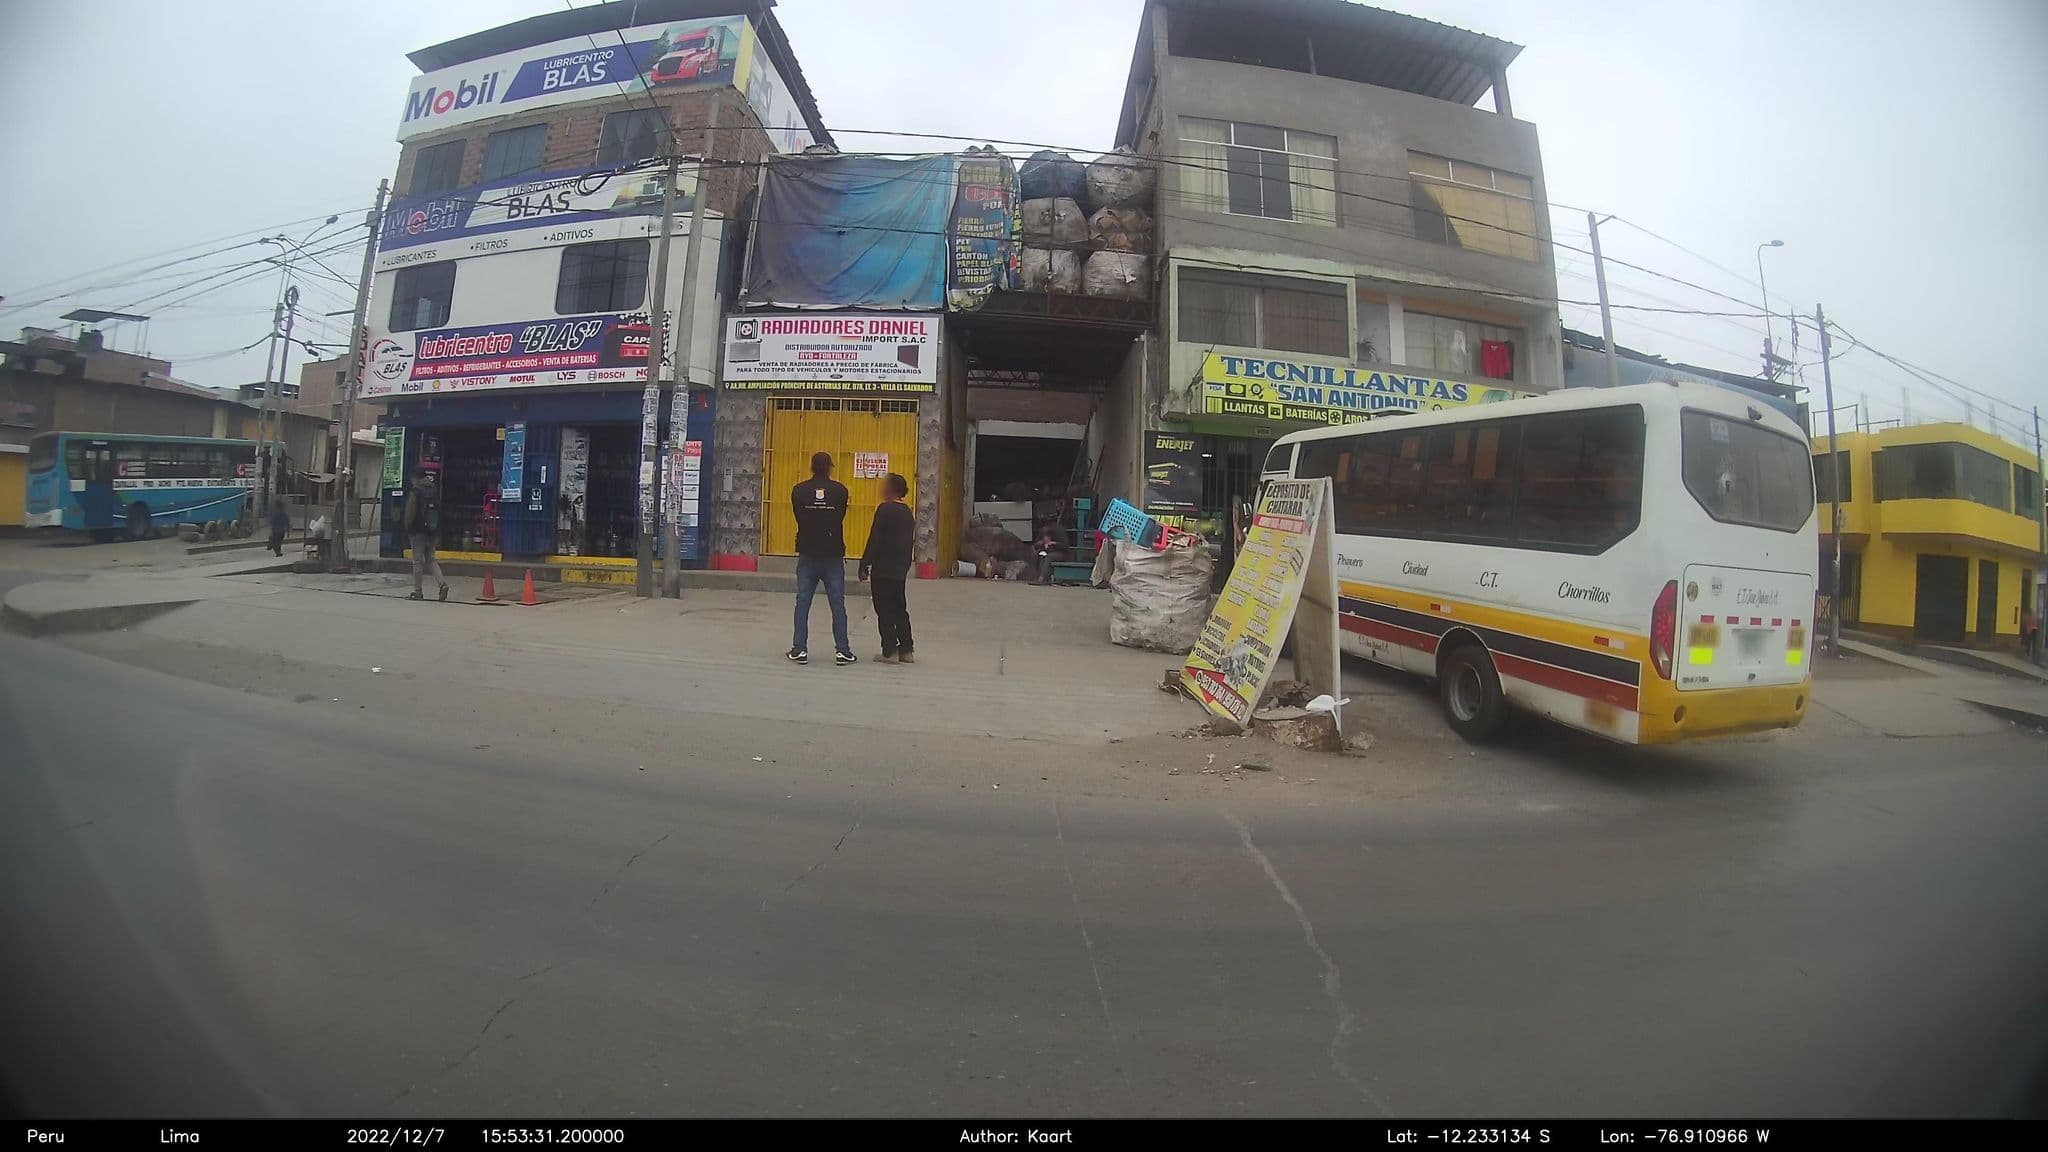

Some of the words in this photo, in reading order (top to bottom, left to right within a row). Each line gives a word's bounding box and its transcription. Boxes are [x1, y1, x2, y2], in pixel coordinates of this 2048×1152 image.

[543, 50, 614, 70] LUBRICENTRO
[543, 62, 606, 90] BLAS
[404, 71, 499, 122] Mobil
[506, 190, 571, 220] BLAS
[384, 198, 462, 238] Mobil
[386, 250, 437, 266] LUBRICANTES
[475, 239, 508, 250] FILTROS
[550, 229, 594, 242] ADITIVOS
[761, 320, 864, 335] RADIADORES
[868, 320, 928, 336] DANIEL
[419, 332, 513, 360] lubricentro
[901, 336, 927, 344] S.A.C
[383, 362, 408, 374] BLAS
[415, 366, 433, 376] FILTROS
[437, 364, 459, 374] ADITIVOS
[463, 361, 501, 372] REFRIGERANTES
[505, 357, 538, 369] ACCESORIOS
[542, 355, 561, 366] VENTA
[561, 355, 569, 364] DE
[569, 354, 597, 364] BATERIAS
[401, 382, 424, 393] Mobil
[461, 376, 498, 386] VISTONY
[509, 375, 536, 383] MOTUL
[556, 371, 577, 381] LYS
[598, 371, 626, 379] BOSCH
[881, 383, 896, 391] VILLA
[903, 384, 933, 392] SALVADOR
[1220, 355, 1468, 402] TECNILLANTAS
[1224, 401, 1265, 415] LLANTAS
[1285, 407, 1328, 422] BATERÍAS
[1344, 414, 1369, 425] AROS
[1155, 439, 1195, 452] ENERJET
[1266, 501, 1304, 517] CHATARRA
[1402, 560, 1429, 577] Ciudad
[1557, 580, 1612, 604] Chorrillos
